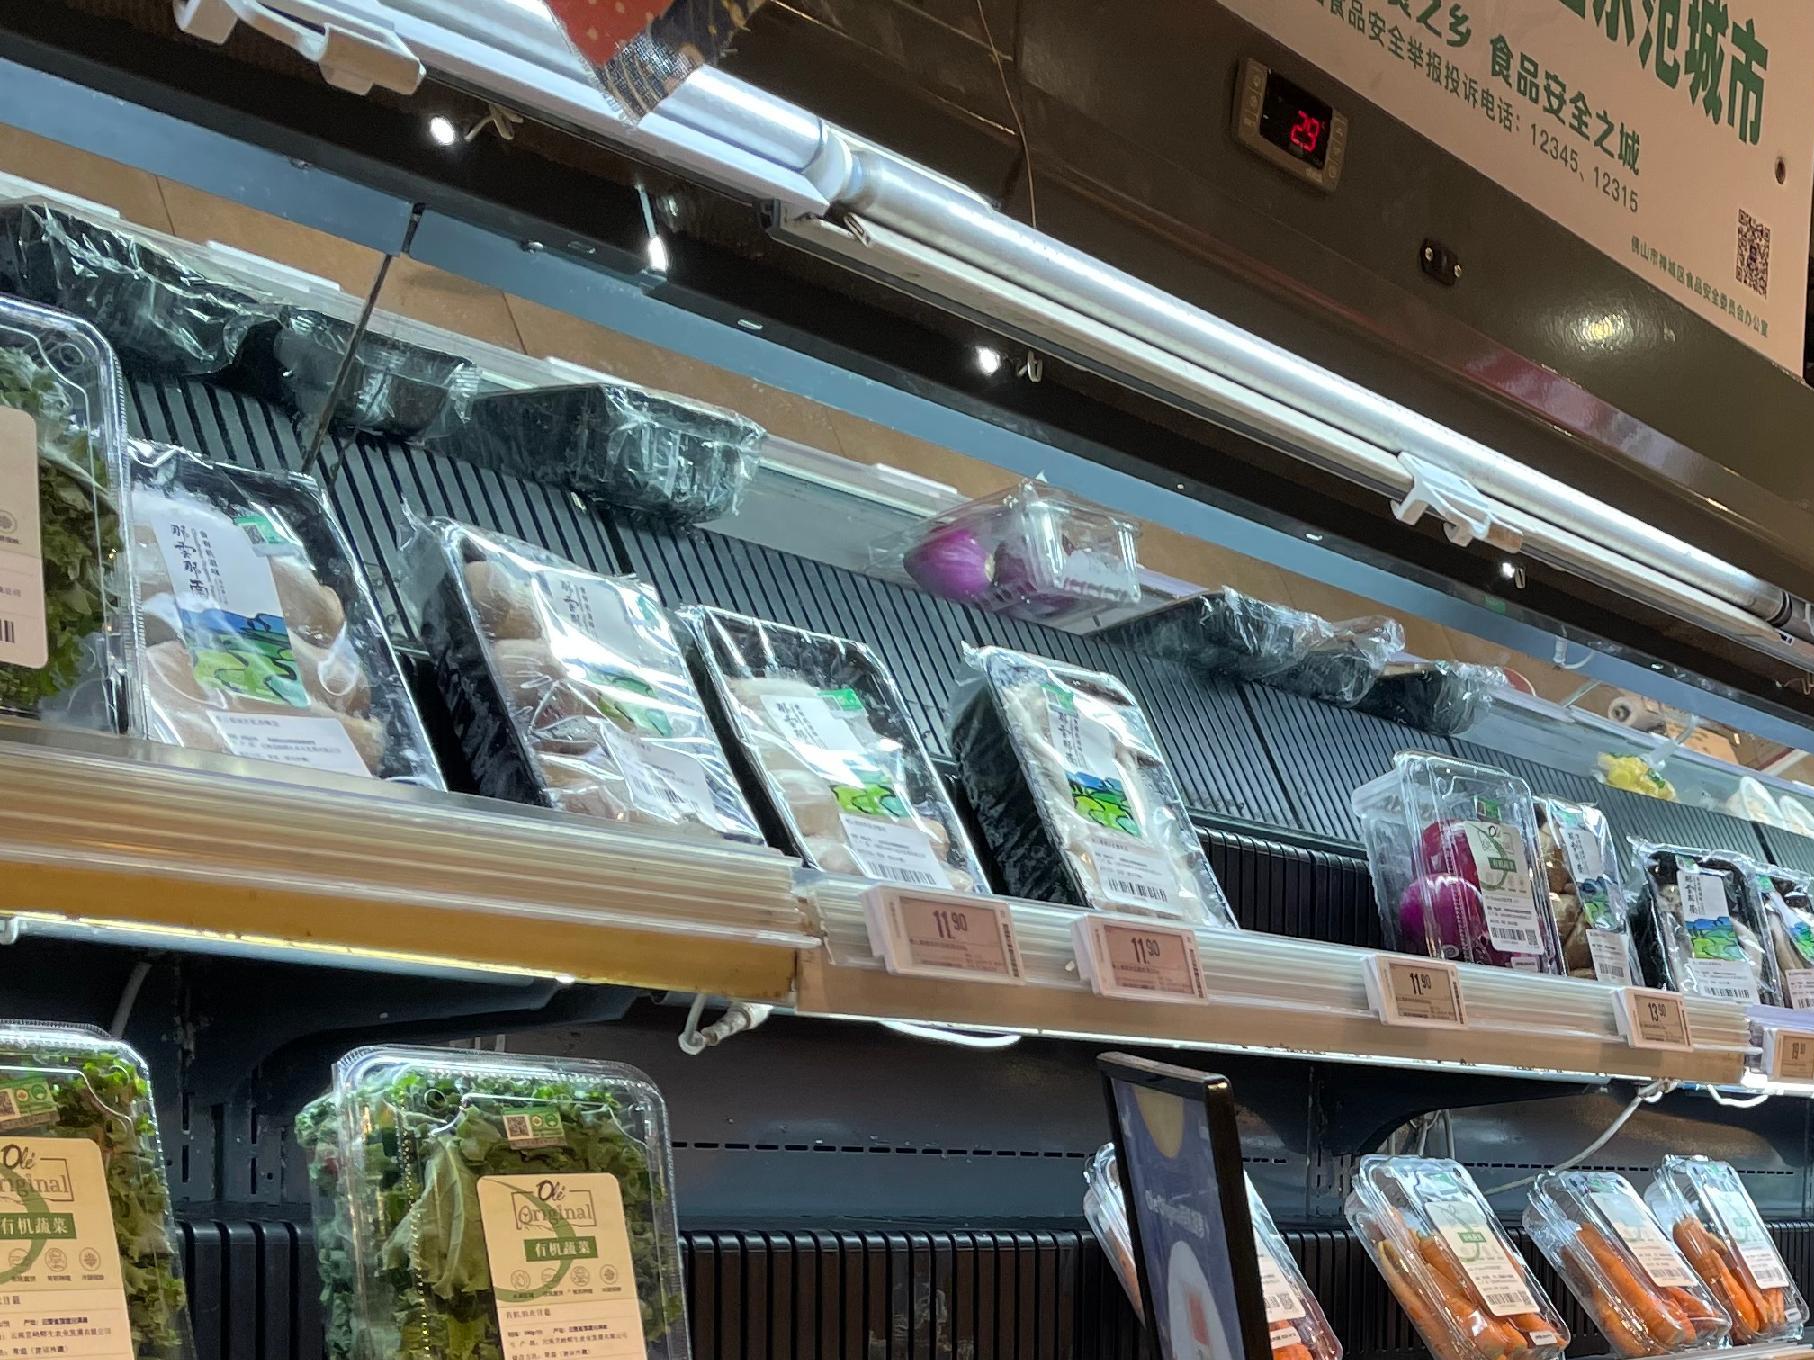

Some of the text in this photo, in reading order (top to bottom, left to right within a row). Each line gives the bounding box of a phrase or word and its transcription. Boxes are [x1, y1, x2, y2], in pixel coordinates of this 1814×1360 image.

[1592, 0, 1767, 146] 范城市
[1490, 34, 1640, 176] 食品安全之城
[0, 1173, 69, 1197] riginal
[1, 1217, 68, 1235] 有机蔬菜
[518, 1203, 592, 1227] Original
[535, 1240, 591, 1258] 有机蔬菜
